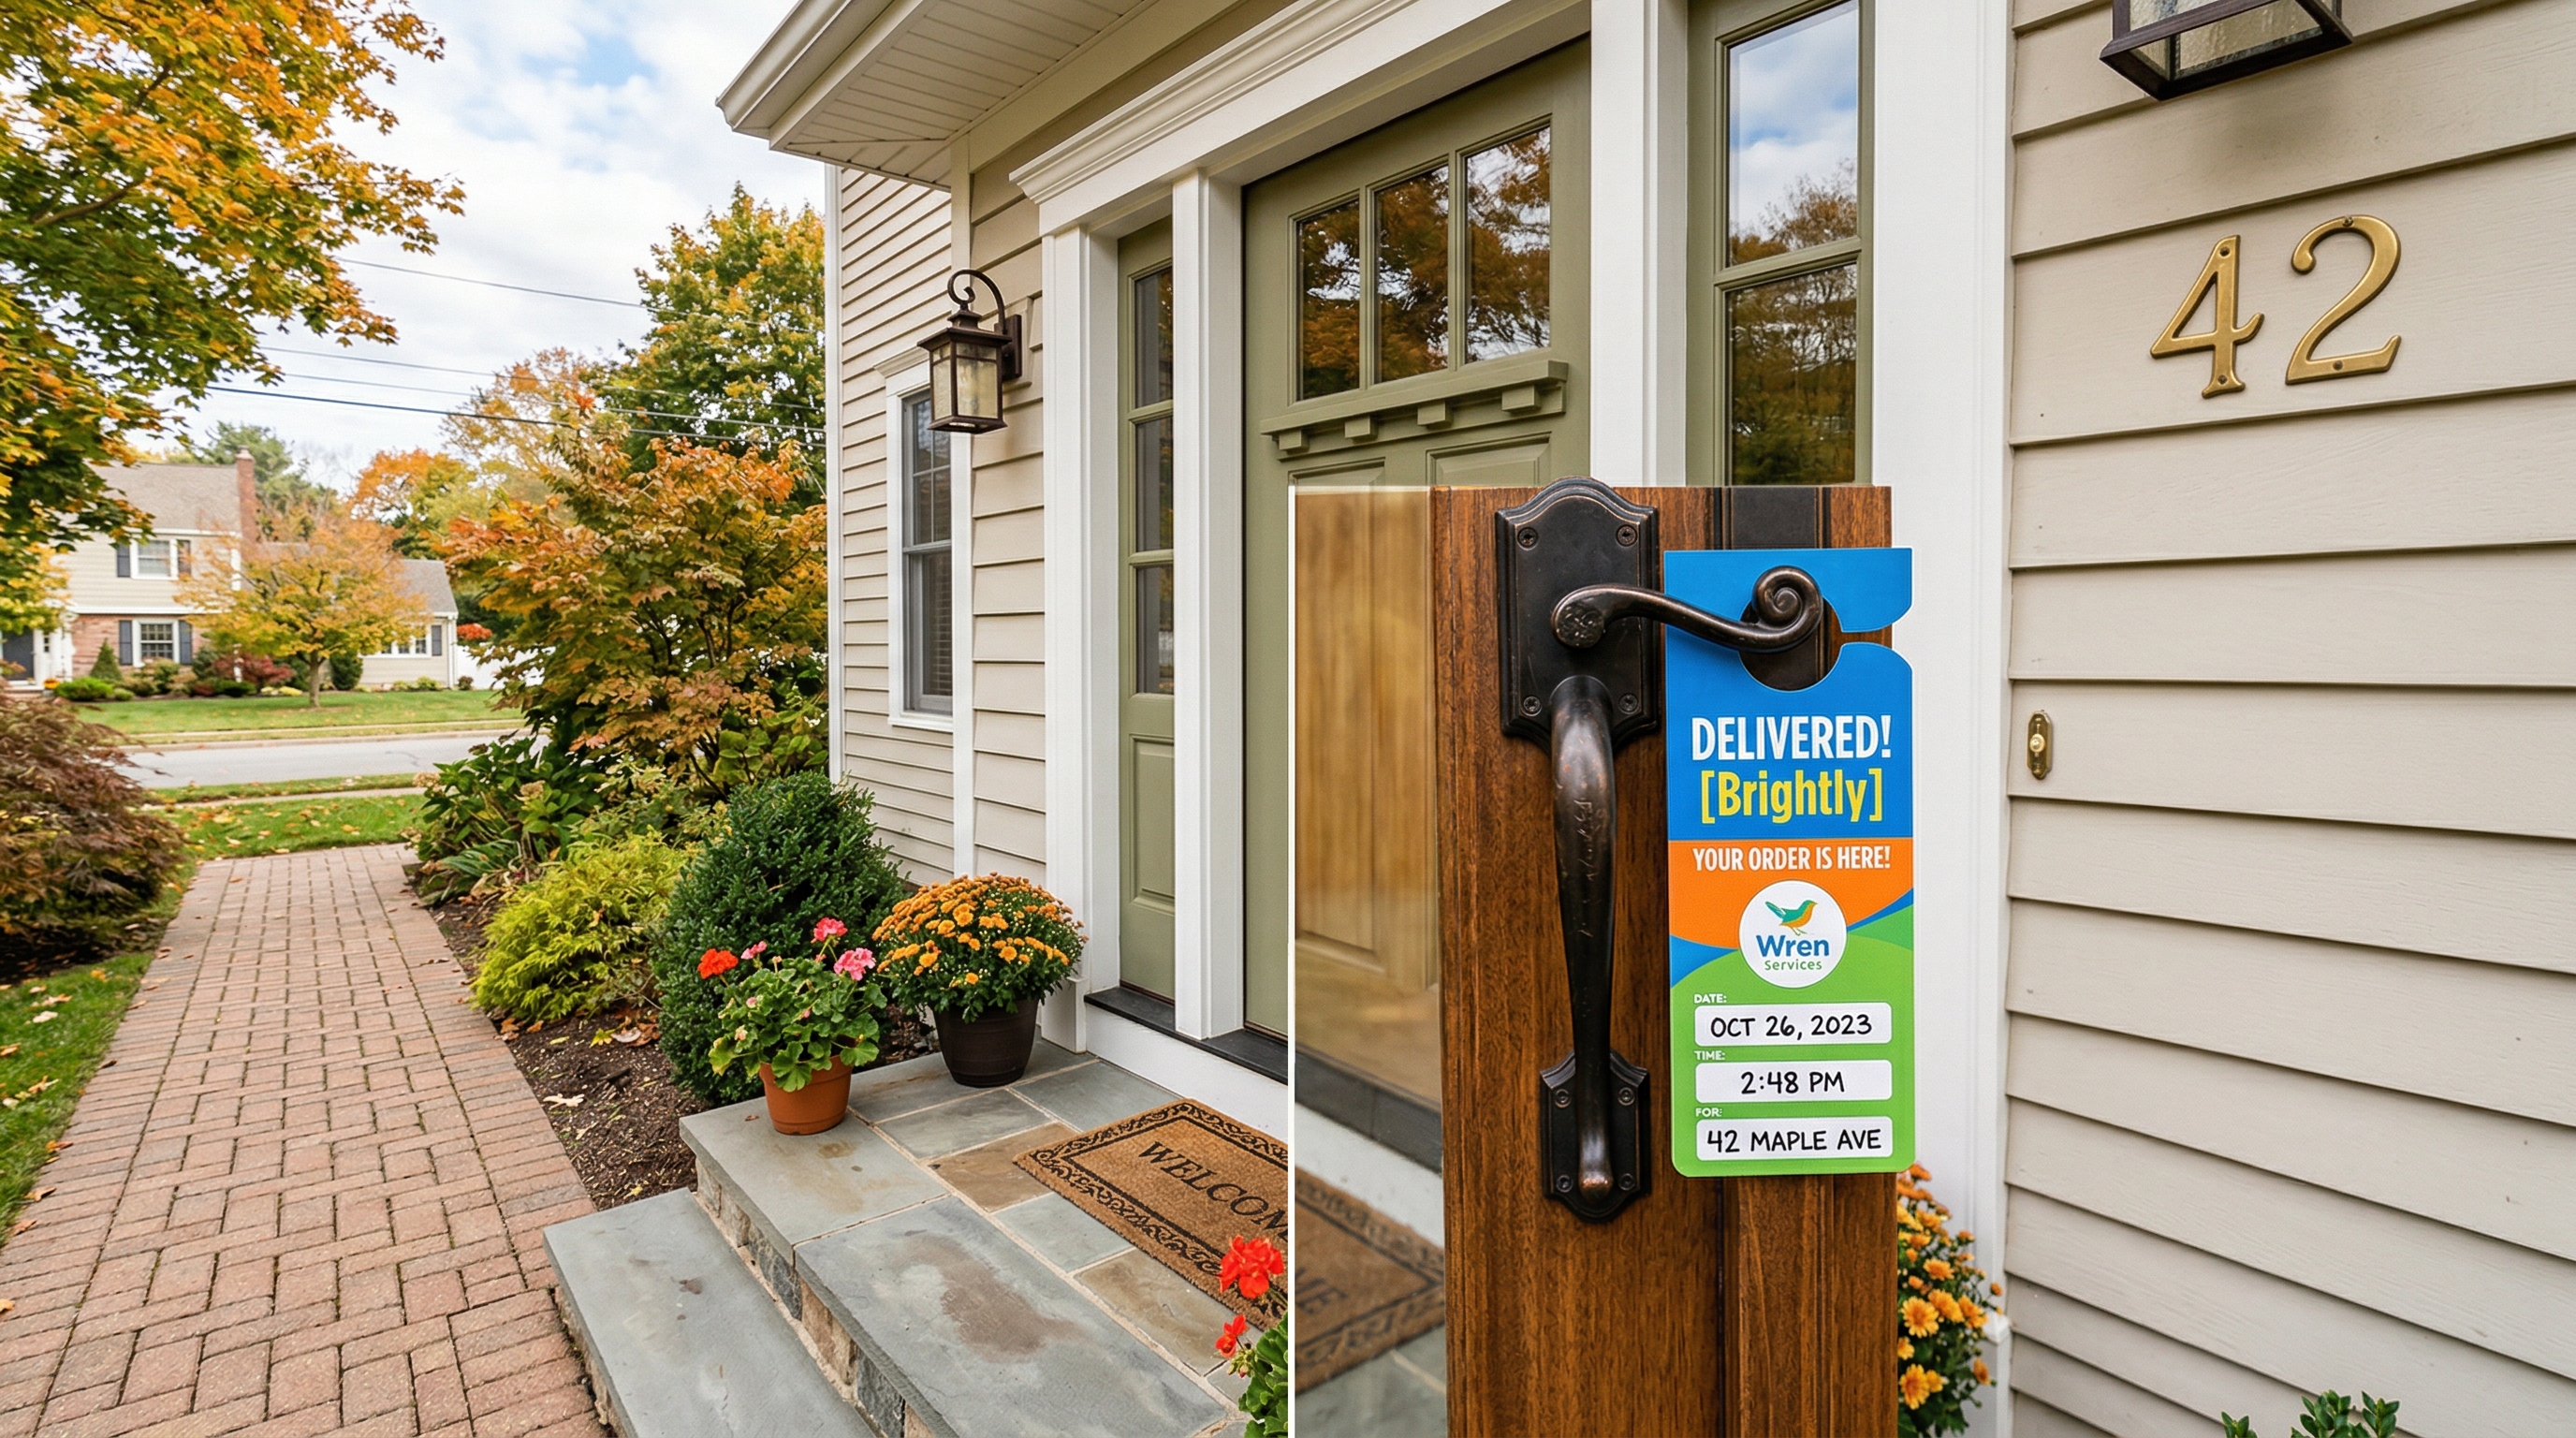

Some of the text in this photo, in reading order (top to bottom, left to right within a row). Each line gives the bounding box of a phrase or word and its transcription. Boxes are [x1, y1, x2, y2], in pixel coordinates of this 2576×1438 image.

[2149, 213, 2402, 400] 42
[1691, 714, 1892, 761] DELIVERED!
[1701, 768, 1882, 824] [Brightly]
[1692, 845, 1891, 872] YOUR ORDER IS HERE!
[1756, 934, 1829, 958] Wren
[1764, 959, 1822, 971] Services
[1693, 993, 1727, 1004] DATE:
[1710, 1014, 1873, 1041] OCT 26, 2023
[1694, 1050, 1726, 1061] TIME:
[1741, 1071, 1845, 1094] 2:48 PM
[1695, 1108, 1722, 1118] FOR:
[1706, 1128, 1882, 1153] 42 MAPLE AVE
